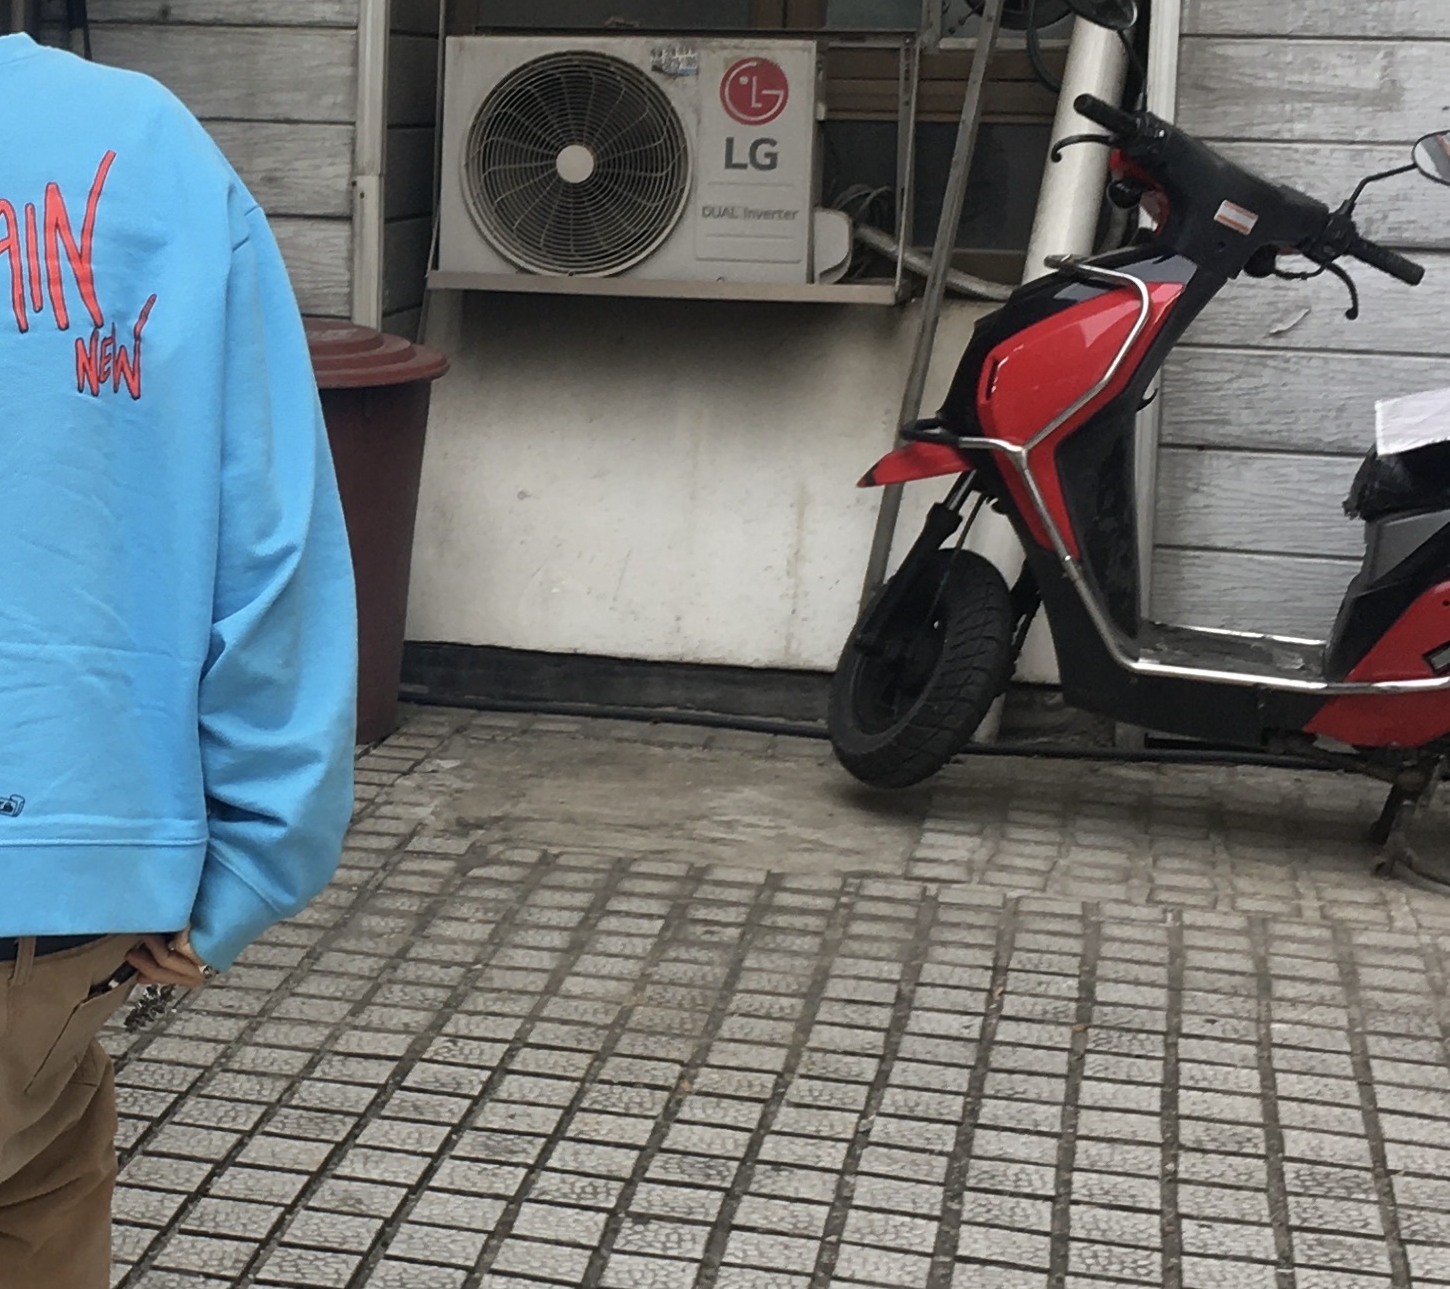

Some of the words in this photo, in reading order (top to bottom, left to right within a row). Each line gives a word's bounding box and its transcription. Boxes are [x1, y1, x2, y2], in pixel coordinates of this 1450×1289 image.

[724, 136, 779, 171] LG
[701, 205, 739, 220] DUAL
[743, 206, 800, 221] Inverter
[74, 294, 157, 400] NEW
